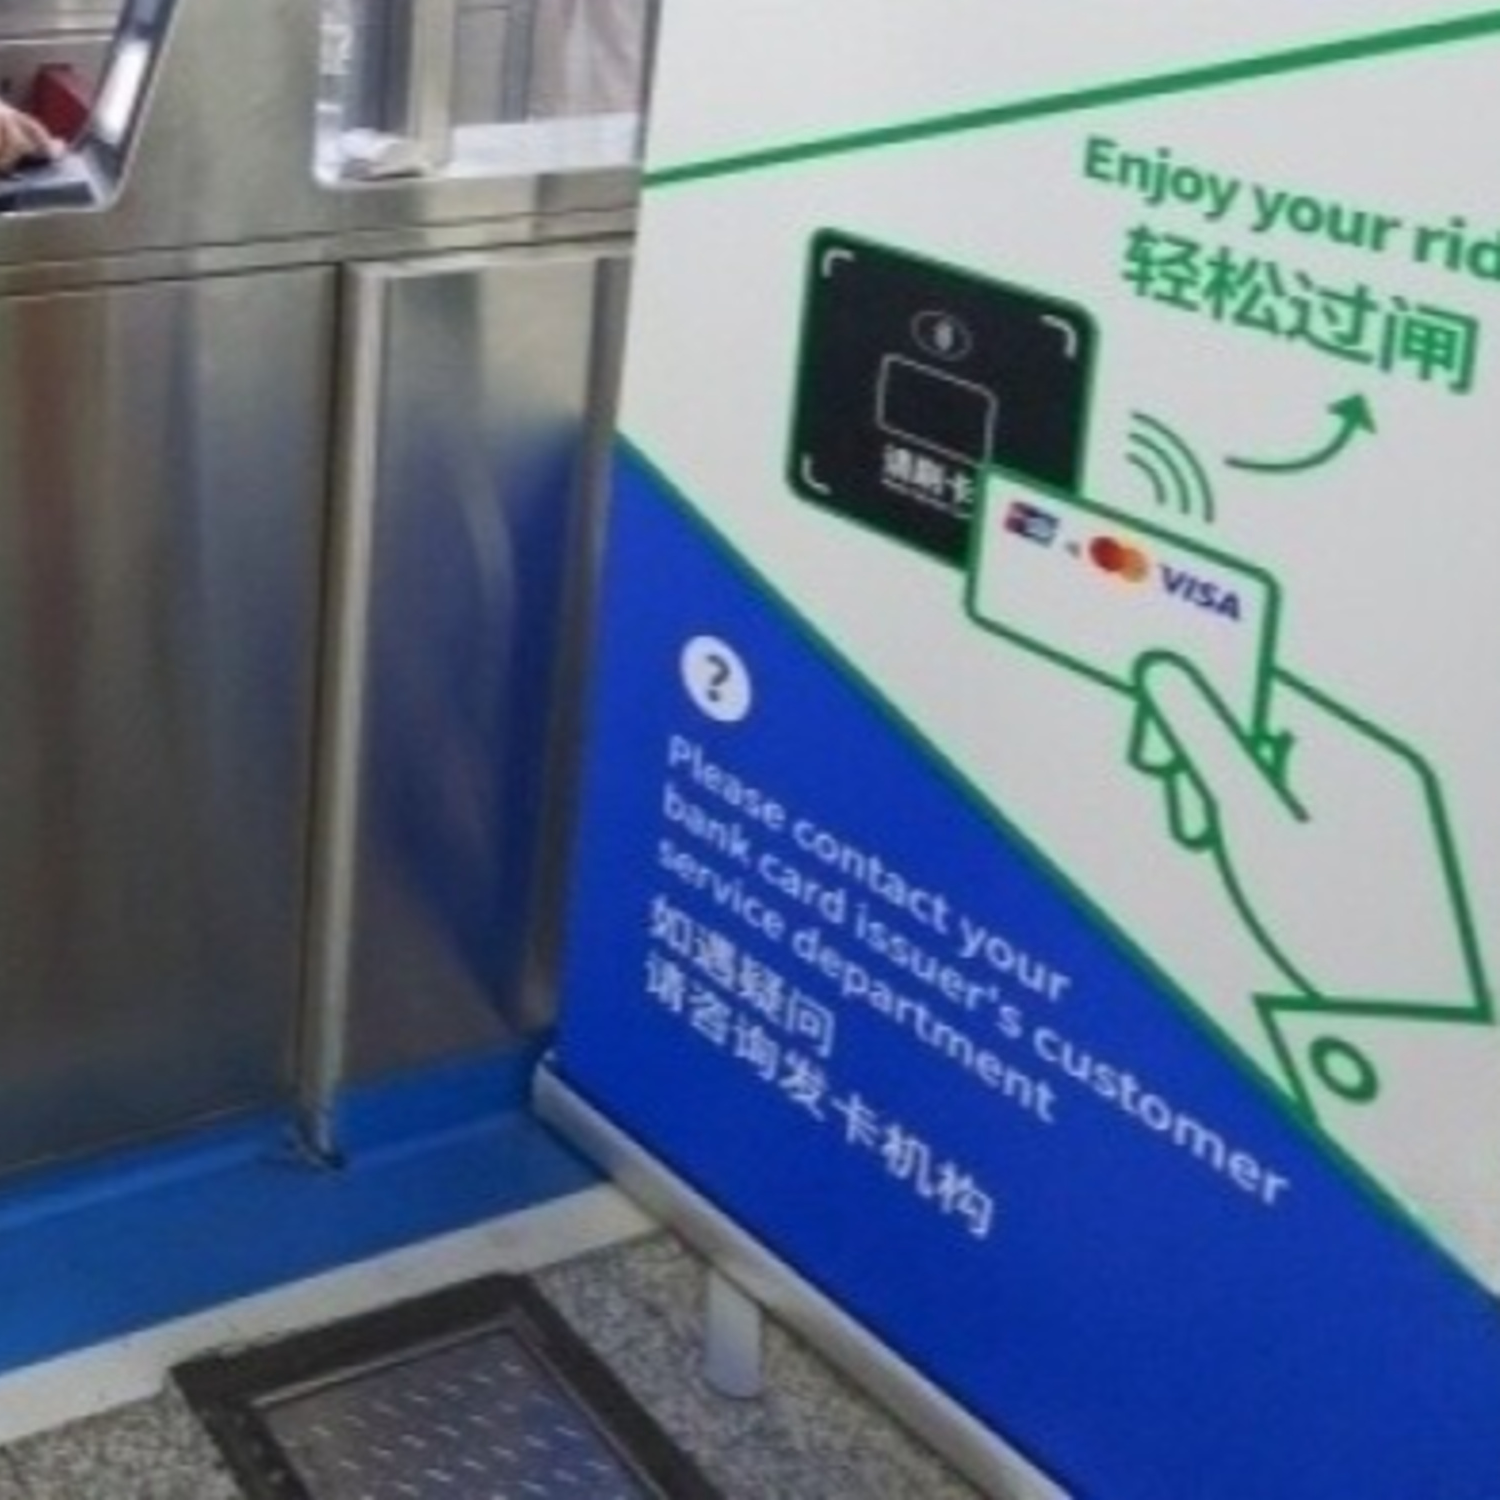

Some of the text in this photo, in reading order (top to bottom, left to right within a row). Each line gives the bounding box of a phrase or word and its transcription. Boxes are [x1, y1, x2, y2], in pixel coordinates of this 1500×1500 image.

[1081, 134, 1242, 220] Enjoy
[1252, 183, 1402, 254] your
[1122, 224, 1480, 395] 轻松过闸
[1158, 563, 1242, 622] VISA
[647, 896, 837, 1058] 如遇疑问
[668, 735, 1072, 1003] Please contact your
[659, 839, 1058, 1123] service department
[662, 782, 1291, 1205] bank card issuer's customer
[645, 950, 995, 1240] 请咨询发卡机构
